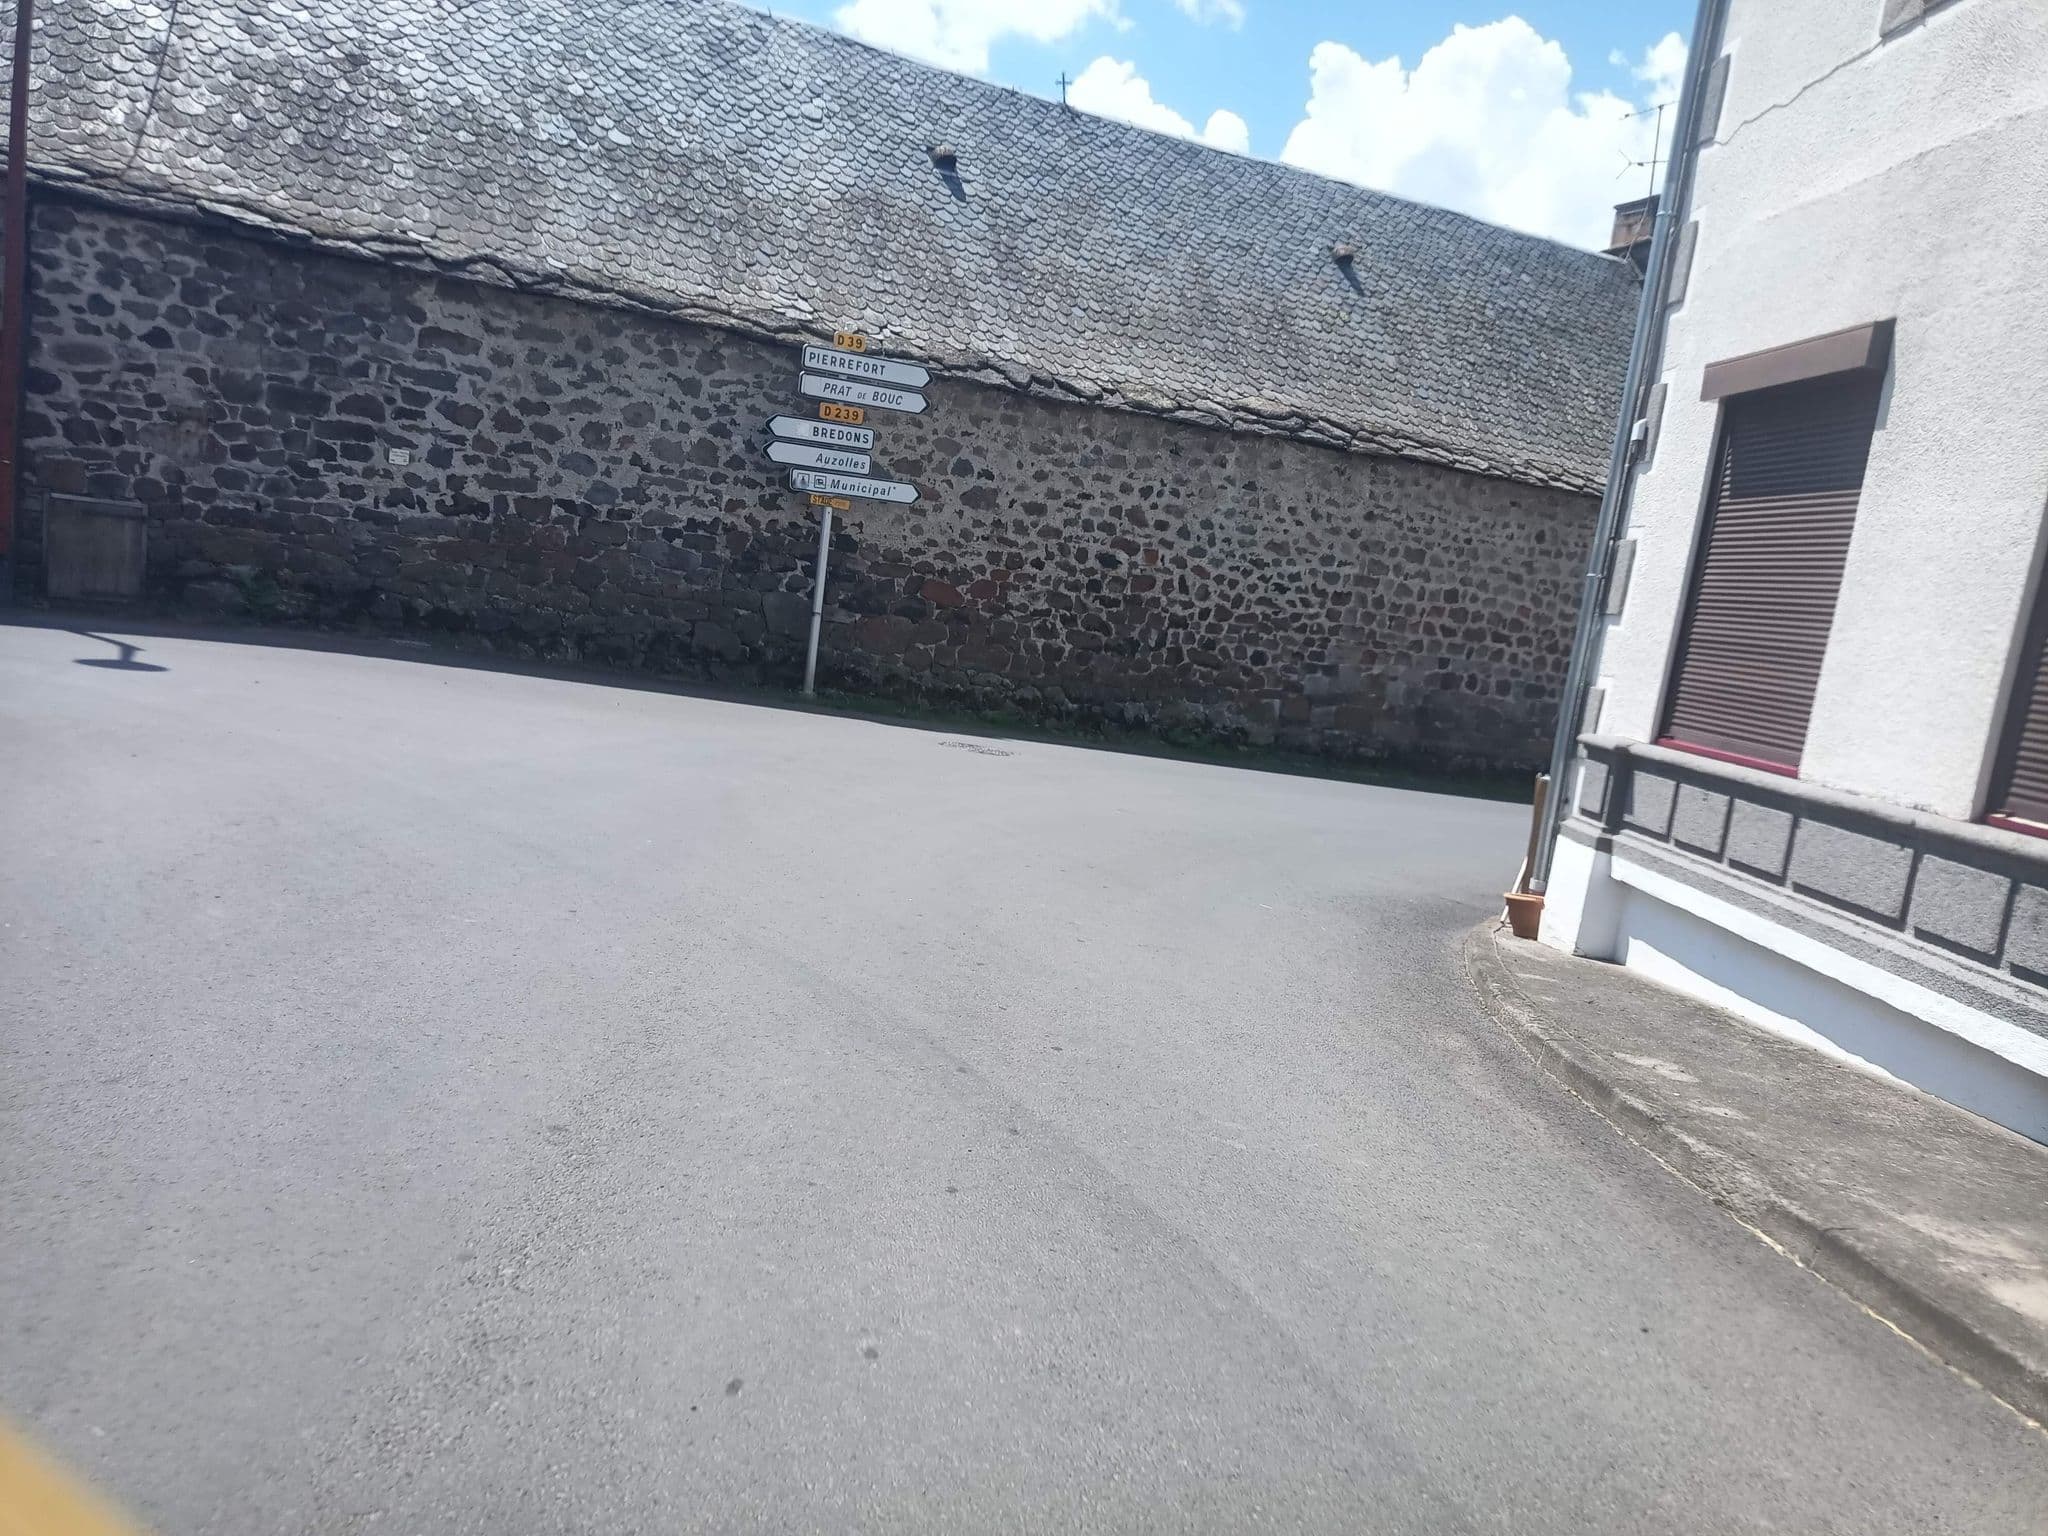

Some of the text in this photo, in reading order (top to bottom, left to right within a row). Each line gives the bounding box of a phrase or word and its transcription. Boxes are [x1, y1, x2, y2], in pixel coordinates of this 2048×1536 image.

[837, 335, 863, 349] D 39
[808, 352, 886, 376] PIERREFORT
[823, 382, 852, 396] PRAT
[872, 391, 903, 406] BOUC
[824, 406, 859, 421] D 239
[812, 427, 870, 444] BREDONS
[815, 453, 866, 470] Auzolles
